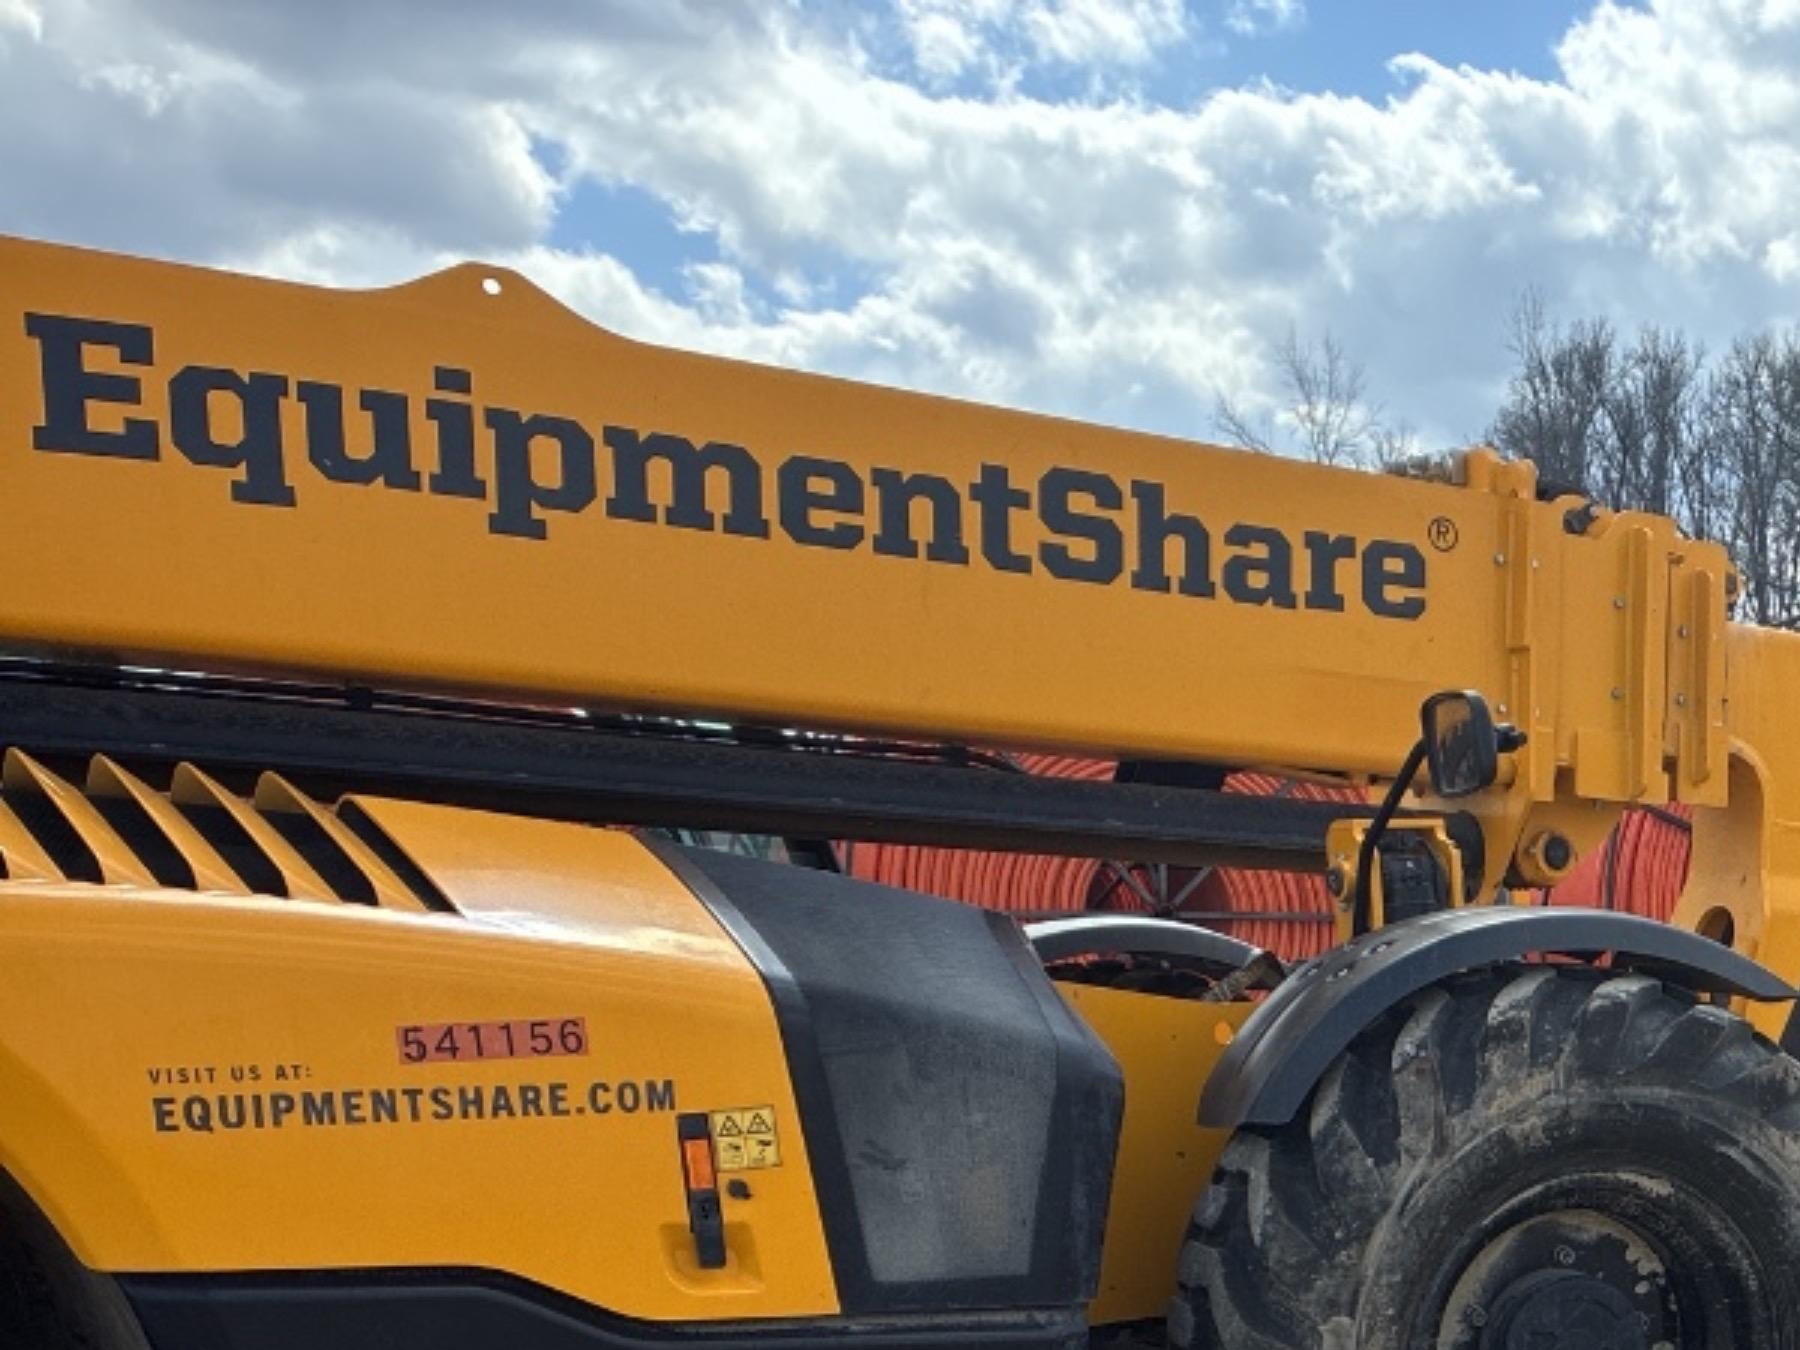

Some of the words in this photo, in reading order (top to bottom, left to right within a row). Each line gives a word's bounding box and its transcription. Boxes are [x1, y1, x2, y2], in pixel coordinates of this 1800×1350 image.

[403, 1020, 583, 1061] 541156
[148, 1067, 216, 1084] VISIT
[231, 1065, 261, 1083] US
[275, 1064, 313, 1081] AT:
[152, 1080, 676, 1134] EQUIPMENTSHARE.COM
